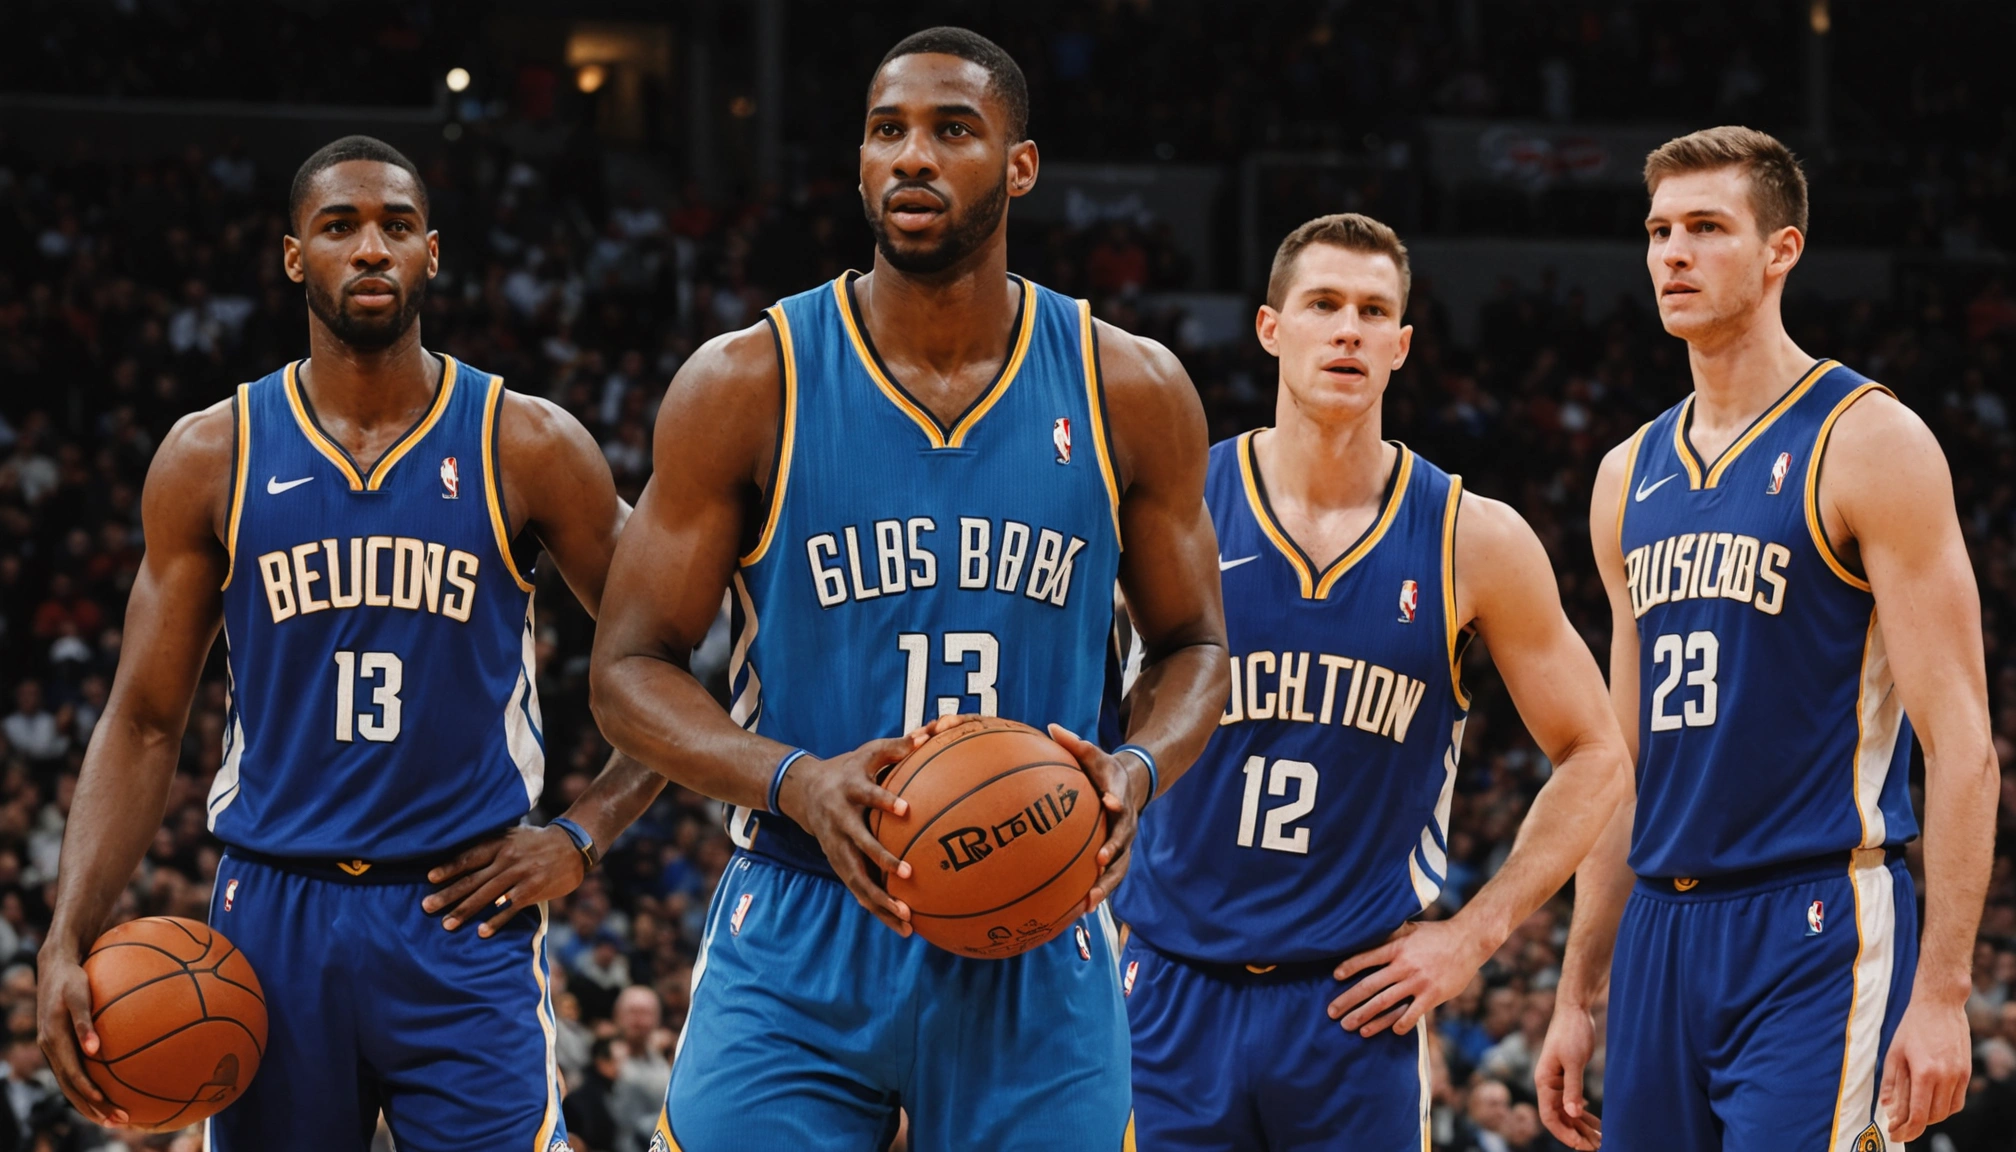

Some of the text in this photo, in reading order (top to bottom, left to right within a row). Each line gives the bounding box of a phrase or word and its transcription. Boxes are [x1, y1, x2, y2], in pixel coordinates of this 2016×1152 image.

[334, 651, 402, 742] 13
[898, 633, 999, 738] 13
[1651, 631, 1719, 732] 23
[1237, 755, 1319, 854] 12
